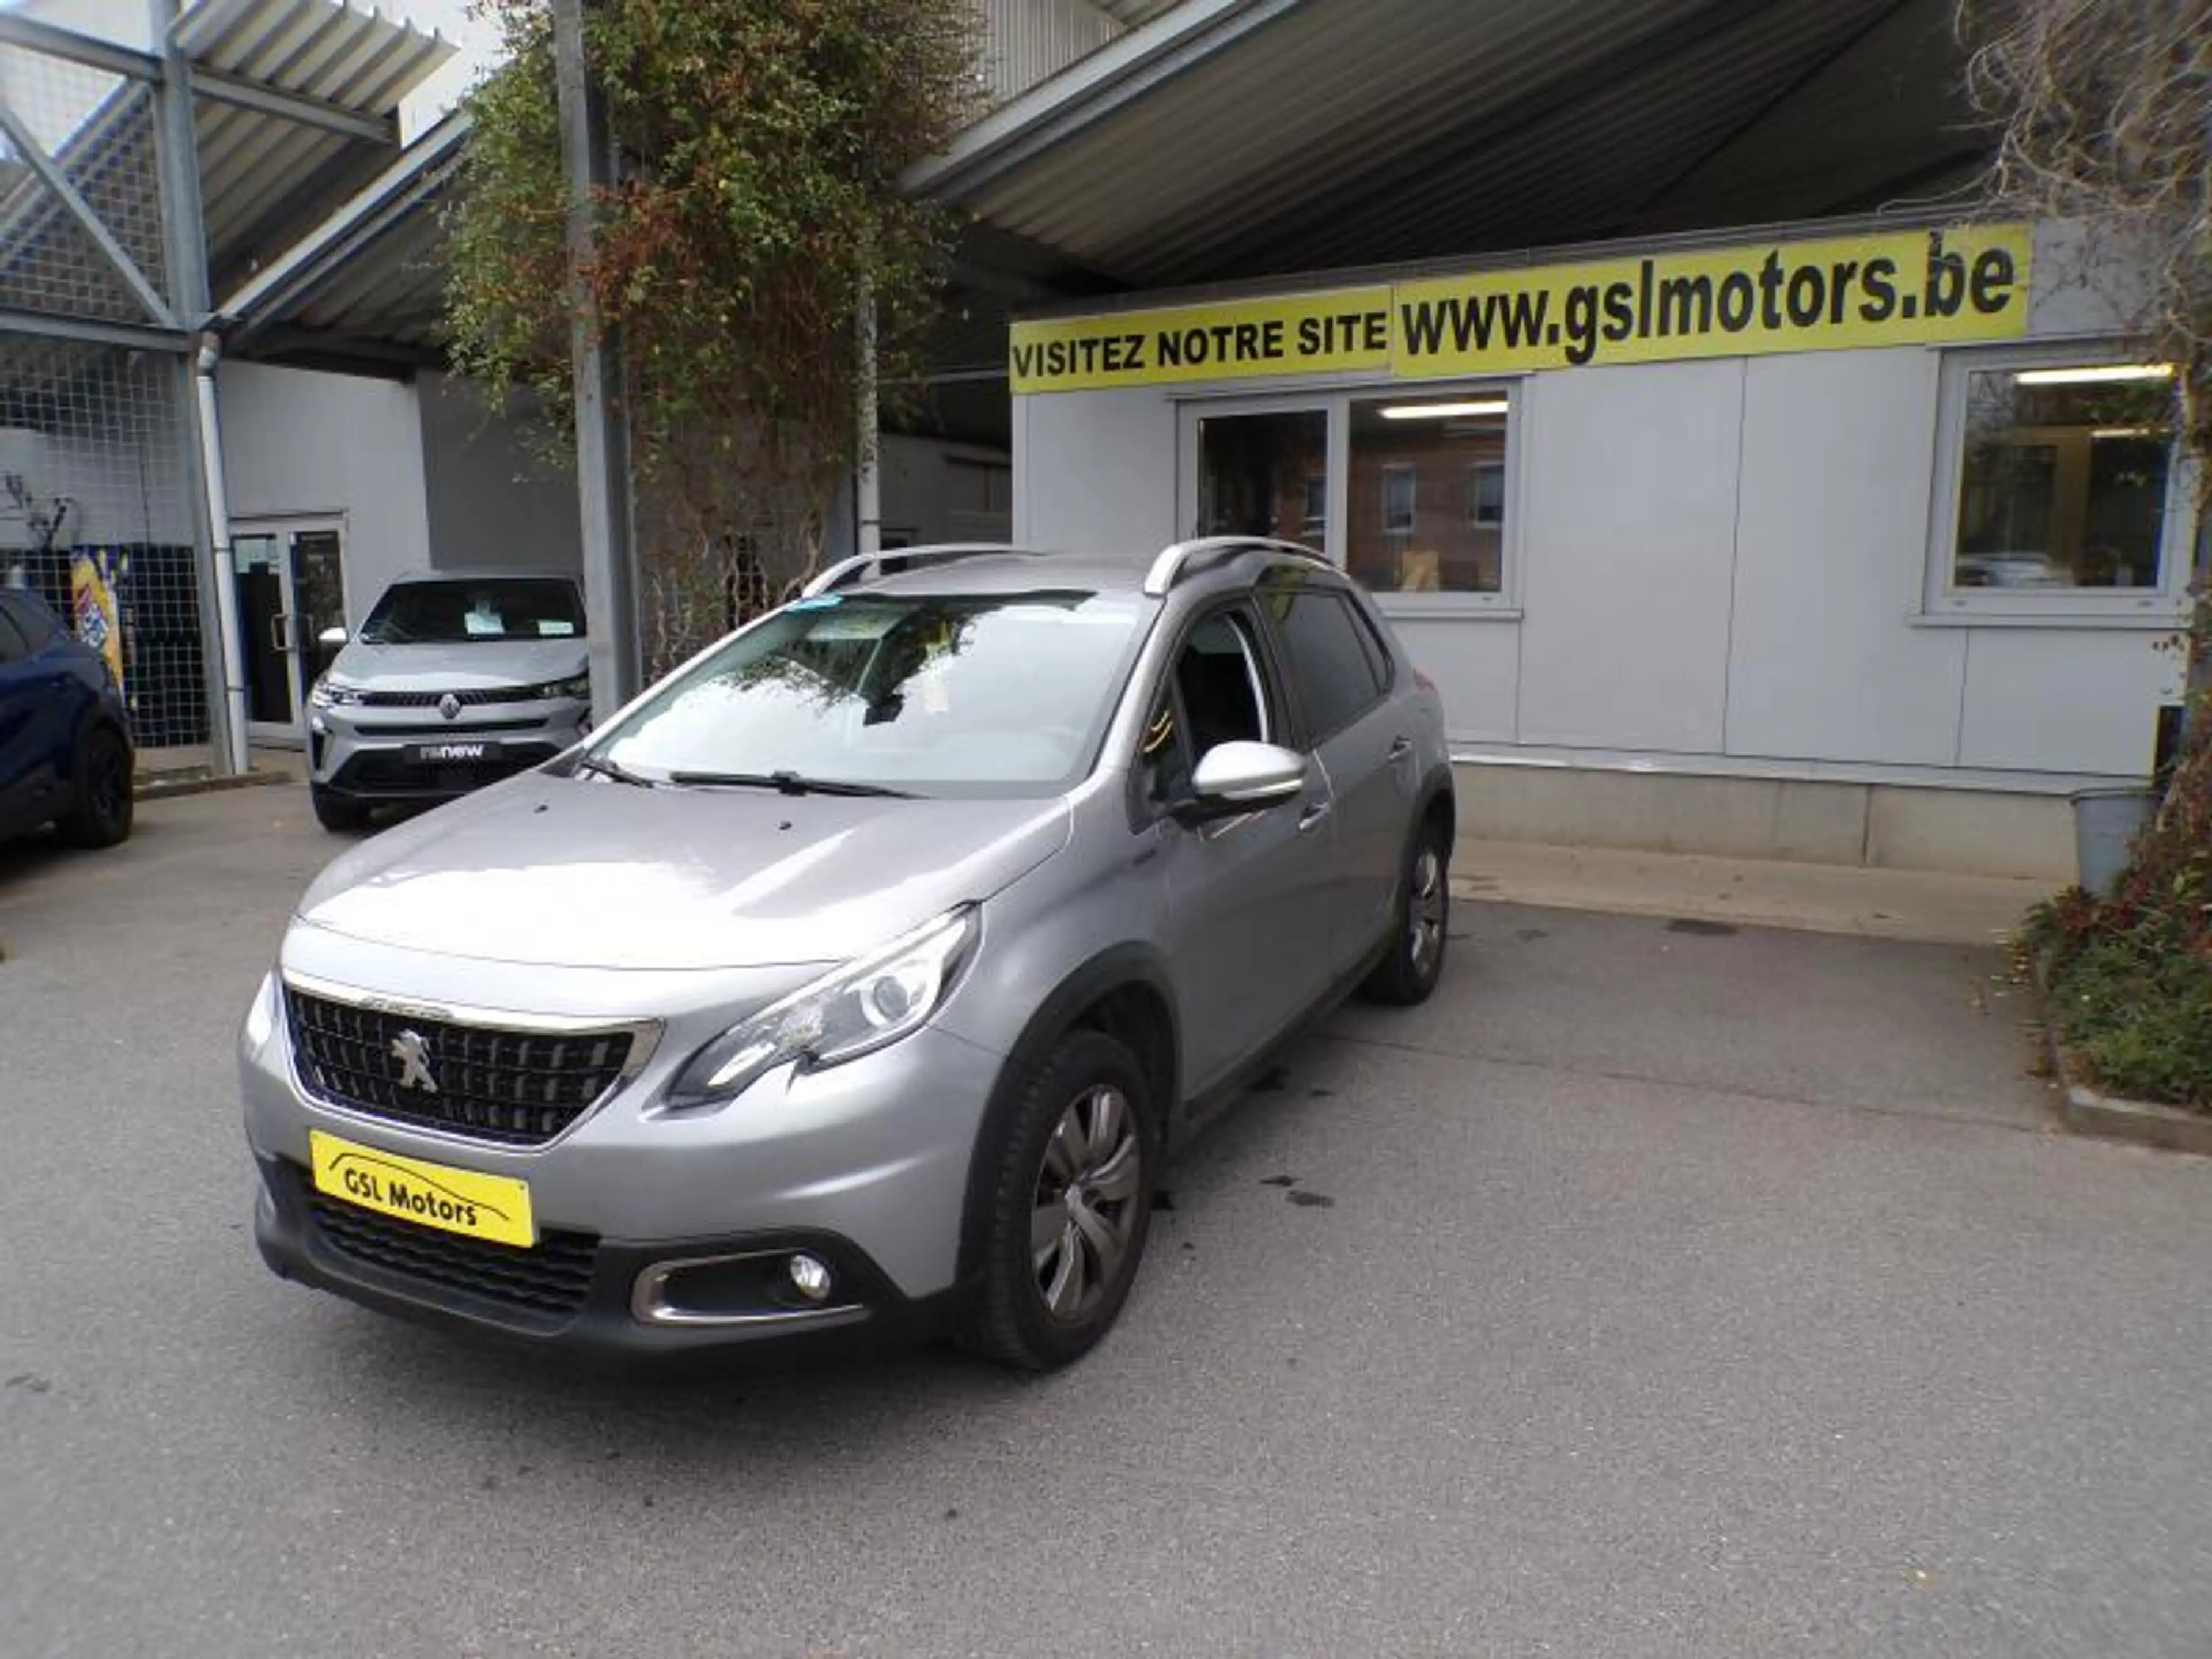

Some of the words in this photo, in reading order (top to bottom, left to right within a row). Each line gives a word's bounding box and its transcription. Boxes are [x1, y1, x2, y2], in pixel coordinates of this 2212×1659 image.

[1402, 230, 2014, 364] www.gslmotors.be
[1013, 334, 1145, 378] VISITEZ
[1157, 320, 1284, 368] NOTRE
[1298, 311, 1387, 355] SITE
[344, 1167, 383, 1202] GSL
[389, 1181, 477, 1226] Motors
